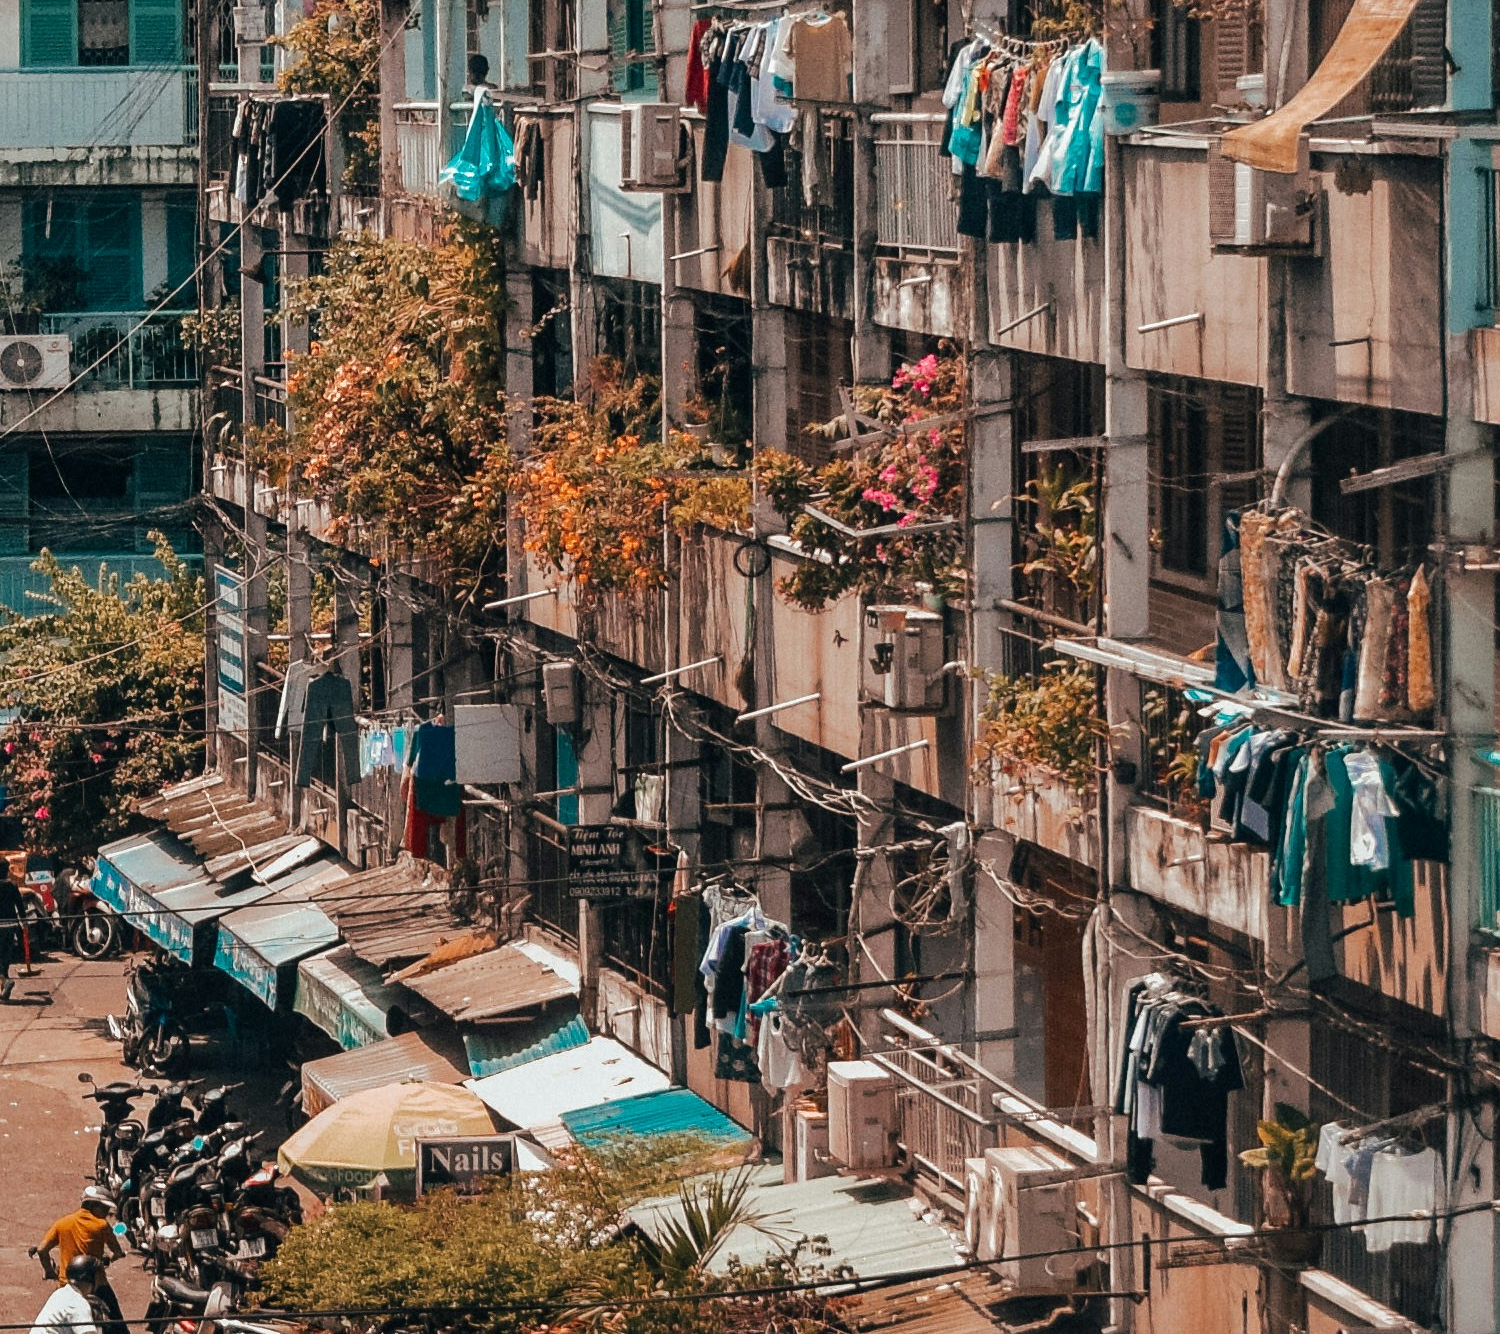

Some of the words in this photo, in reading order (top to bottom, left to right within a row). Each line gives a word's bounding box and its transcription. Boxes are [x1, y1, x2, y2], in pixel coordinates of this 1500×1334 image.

[571, 844, 596, 856] MINH
[598, 843, 620, 856] ANH
[429, 1145, 504, 1172] Nails
